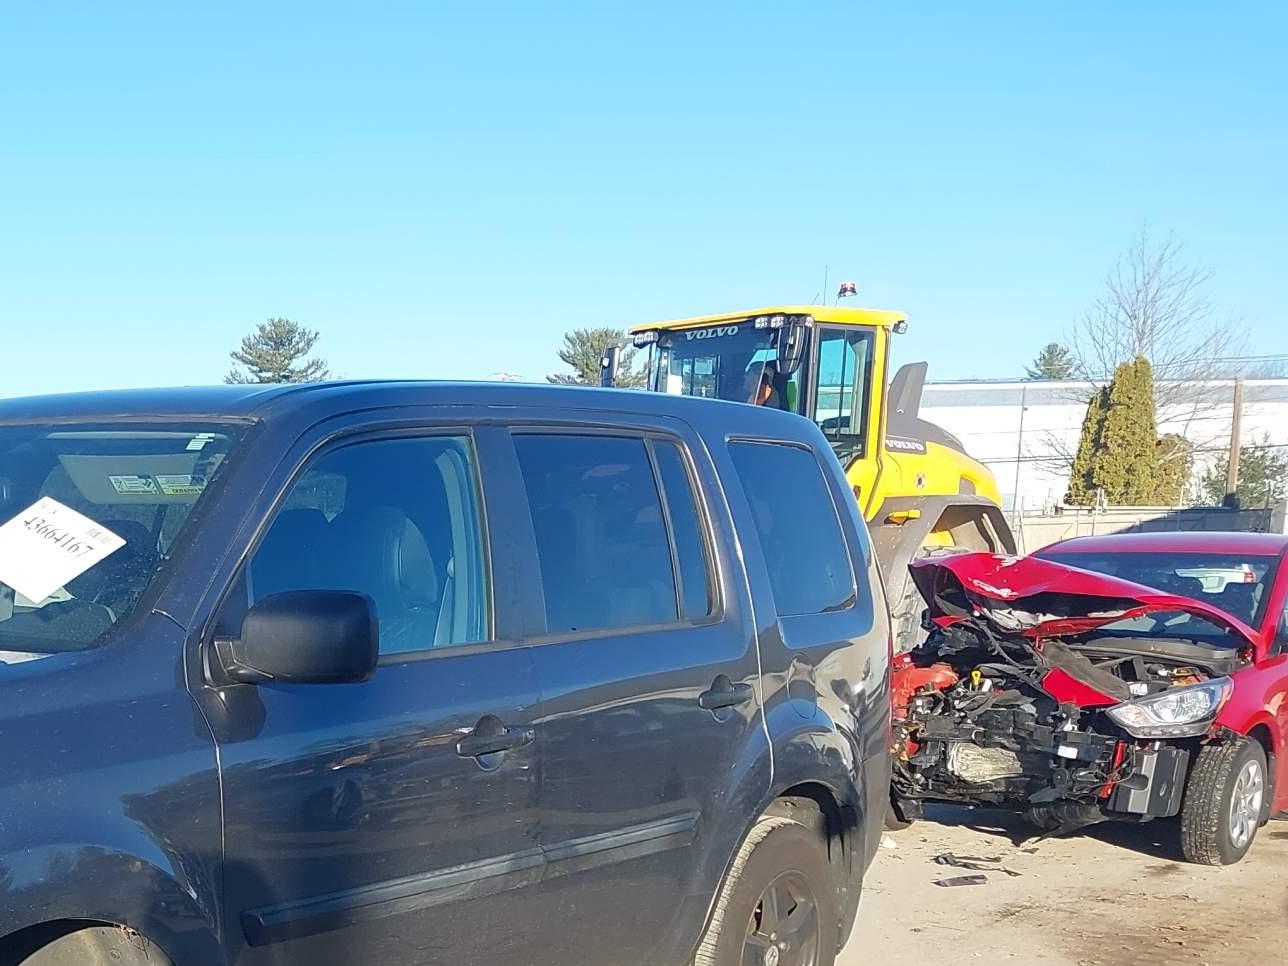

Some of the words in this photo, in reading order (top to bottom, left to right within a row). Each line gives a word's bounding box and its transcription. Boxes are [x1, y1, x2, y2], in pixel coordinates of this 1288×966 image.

[685, 325, 739, 341] VOLVO
[885, 439, 925, 451] VOLVO
[23, 516, 95, 558] 43664167
